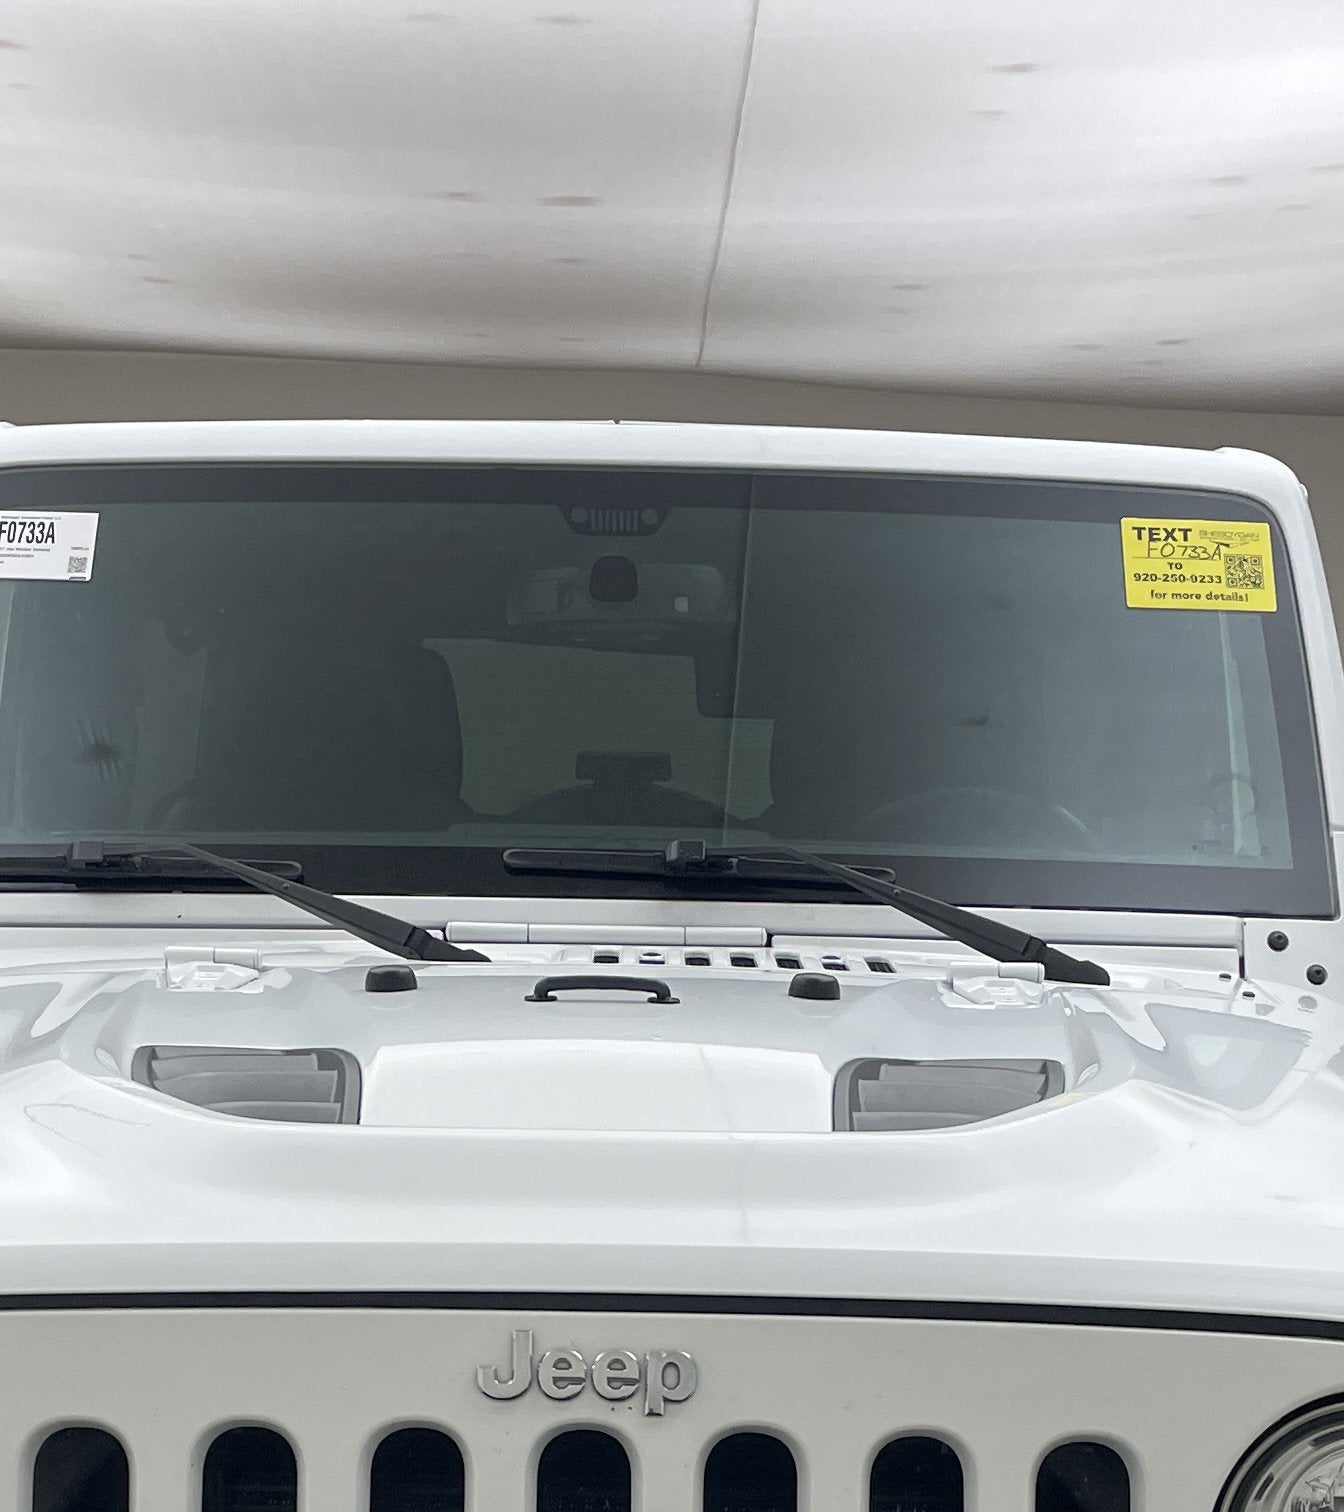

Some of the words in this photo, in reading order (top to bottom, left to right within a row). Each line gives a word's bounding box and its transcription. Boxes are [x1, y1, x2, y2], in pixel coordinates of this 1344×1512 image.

[1132, 526, 1192, 541] TEXT
[1167, 561, 1183, 570] TO
[1150, 589, 1167, 599] for
[1171, 591, 1202, 600] more
[1205, 591, 1249, 602] details!
[476, 1329, 698, 1417] Jeep
